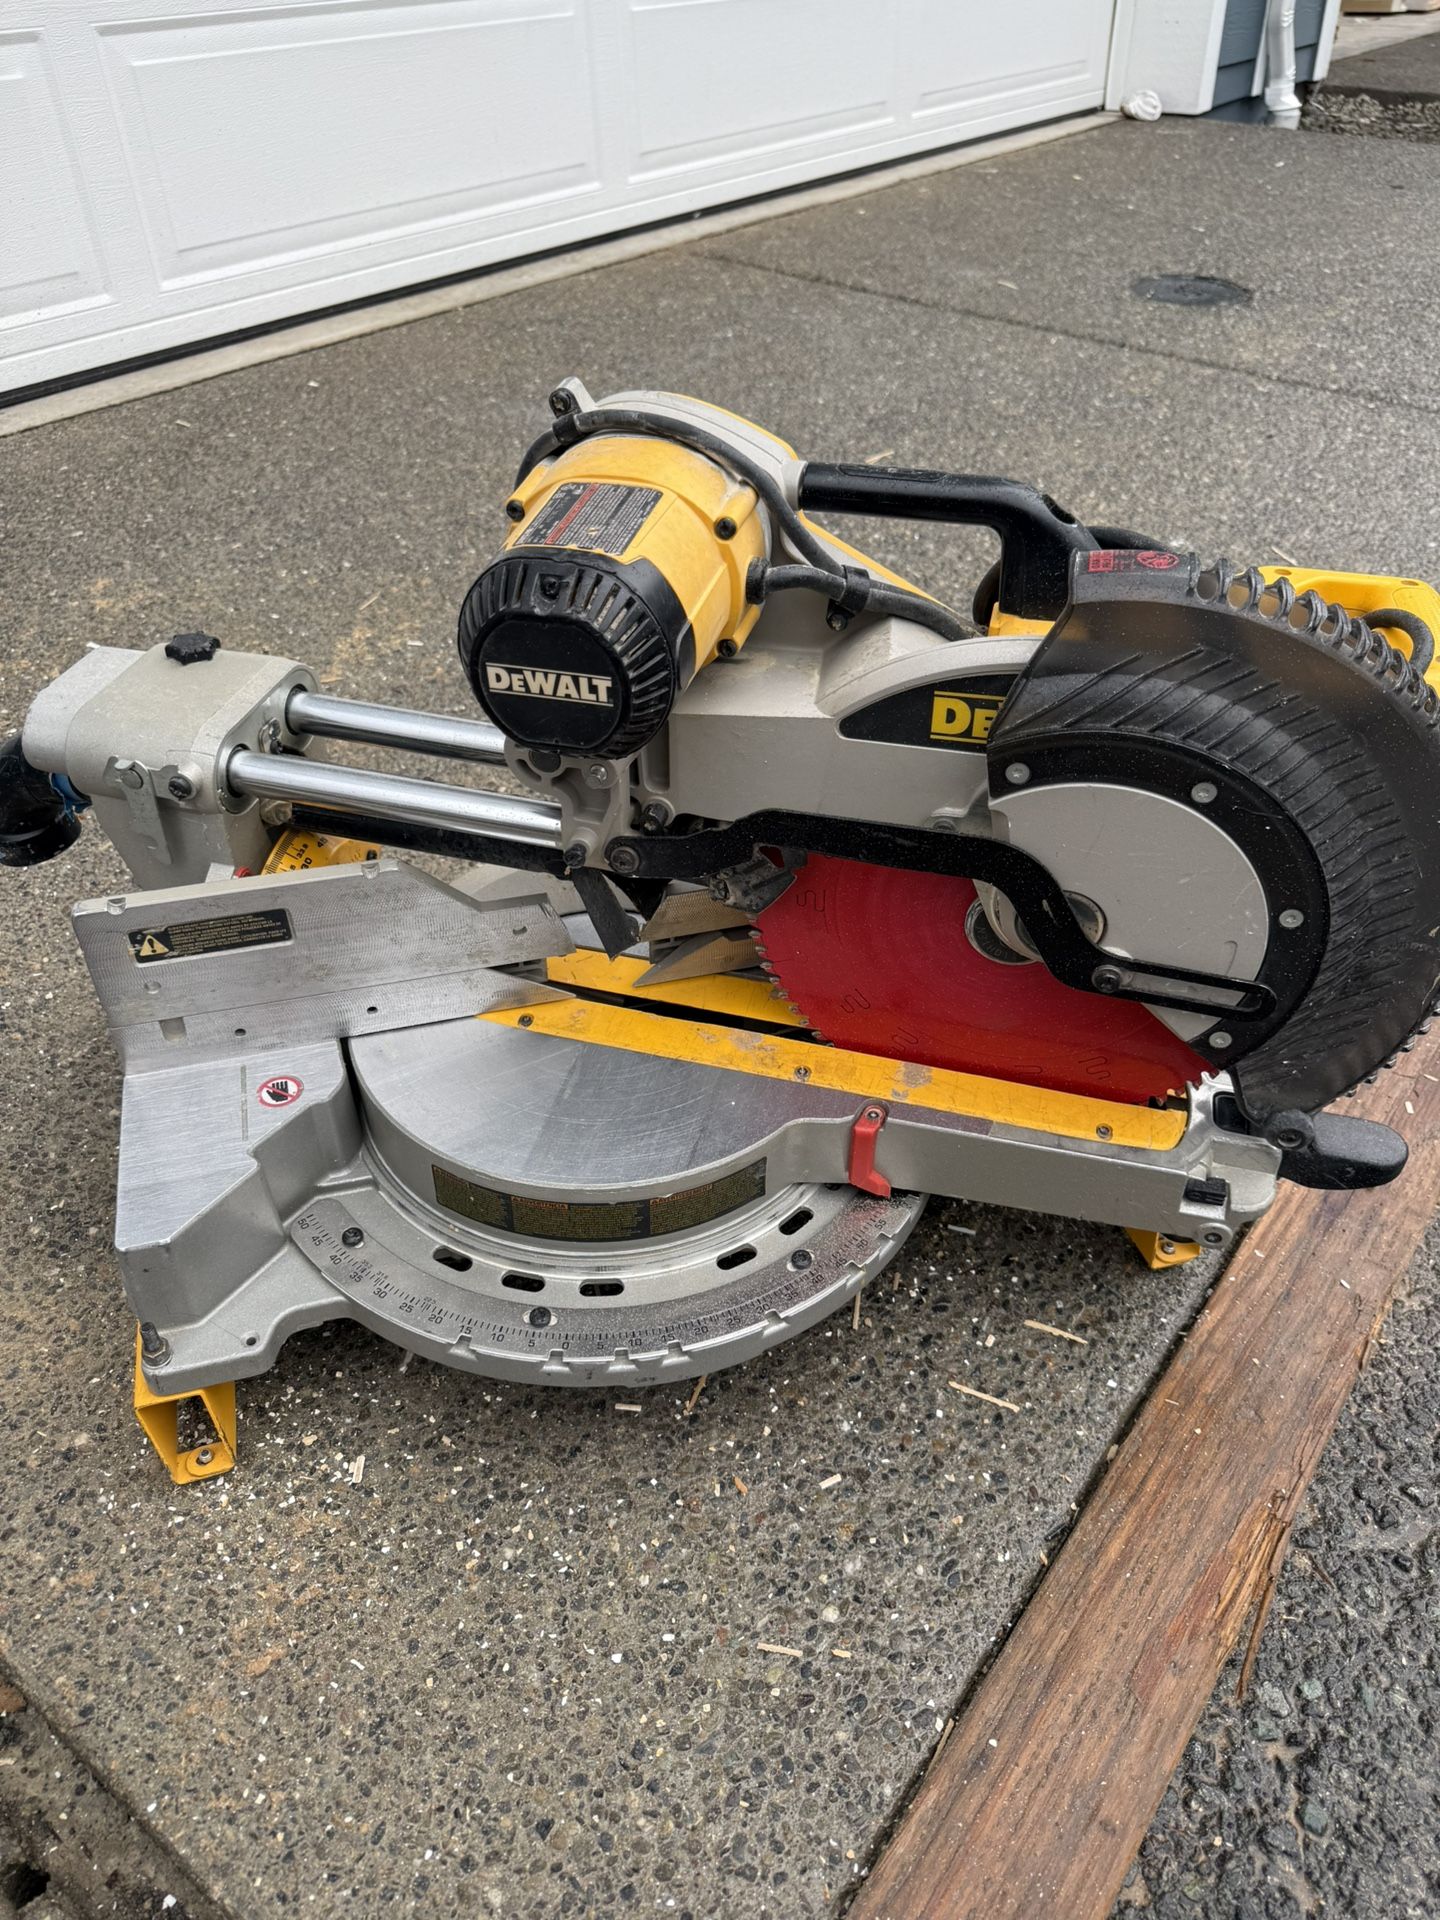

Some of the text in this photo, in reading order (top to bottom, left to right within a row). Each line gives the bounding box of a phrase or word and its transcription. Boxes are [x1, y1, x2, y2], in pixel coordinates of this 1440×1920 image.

[297, 1218, 310, 1230] 50
[311, 1235, 324, 1247] 45
[329, 1253, 343, 1265] 40
[349, 1271, 364, 1283] 35
[373, 1287, 388, 1299] 30
[398, 1302, 414, 1313] 25
[428, 1313, 443, 1324] 20
[459, 1325, 473, 1335] 15
[490, 1333, 505, 1342] 10
[527, 1339, 536, 1348] 5
[561, 1341, 570, 1350] 0
[596, 1341, 605, 1350] 5
[627, 1338, 642, 1347] 10
[661, 1333, 675, 1342] 15
[694, 1325, 709, 1336] 20
[726, 1316, 741, 1327] 25
[756, 1303, 771, 1314] 30
[784, 1290, 799, 1301] 35
[835, 1257, 848, 1269] 45
[874, 1218, 887, 1230] 55
